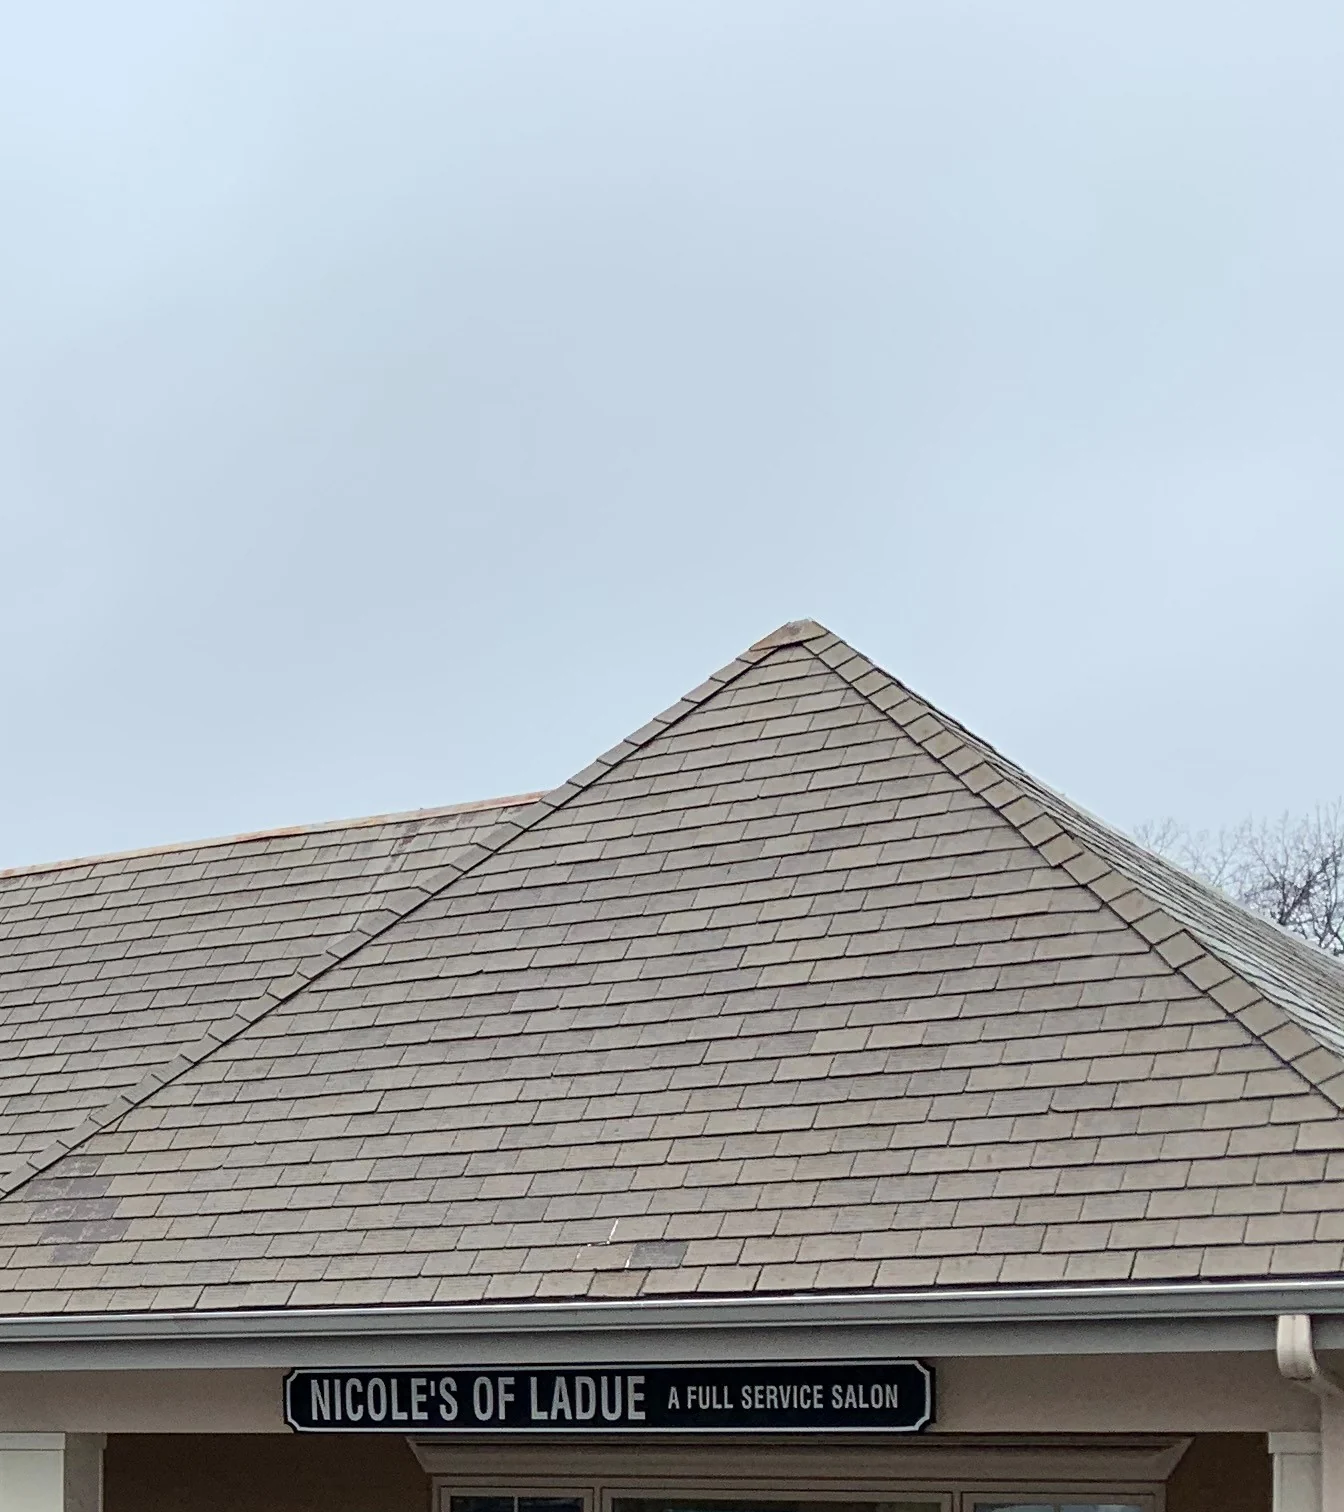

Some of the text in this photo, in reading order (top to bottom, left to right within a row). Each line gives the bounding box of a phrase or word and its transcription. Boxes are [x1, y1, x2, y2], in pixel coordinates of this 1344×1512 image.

[311, 1374, 646, 1422] NICOLE'S OF LADUE
[667, 1384, 899, 1410] A FULL SERVICE SALON
